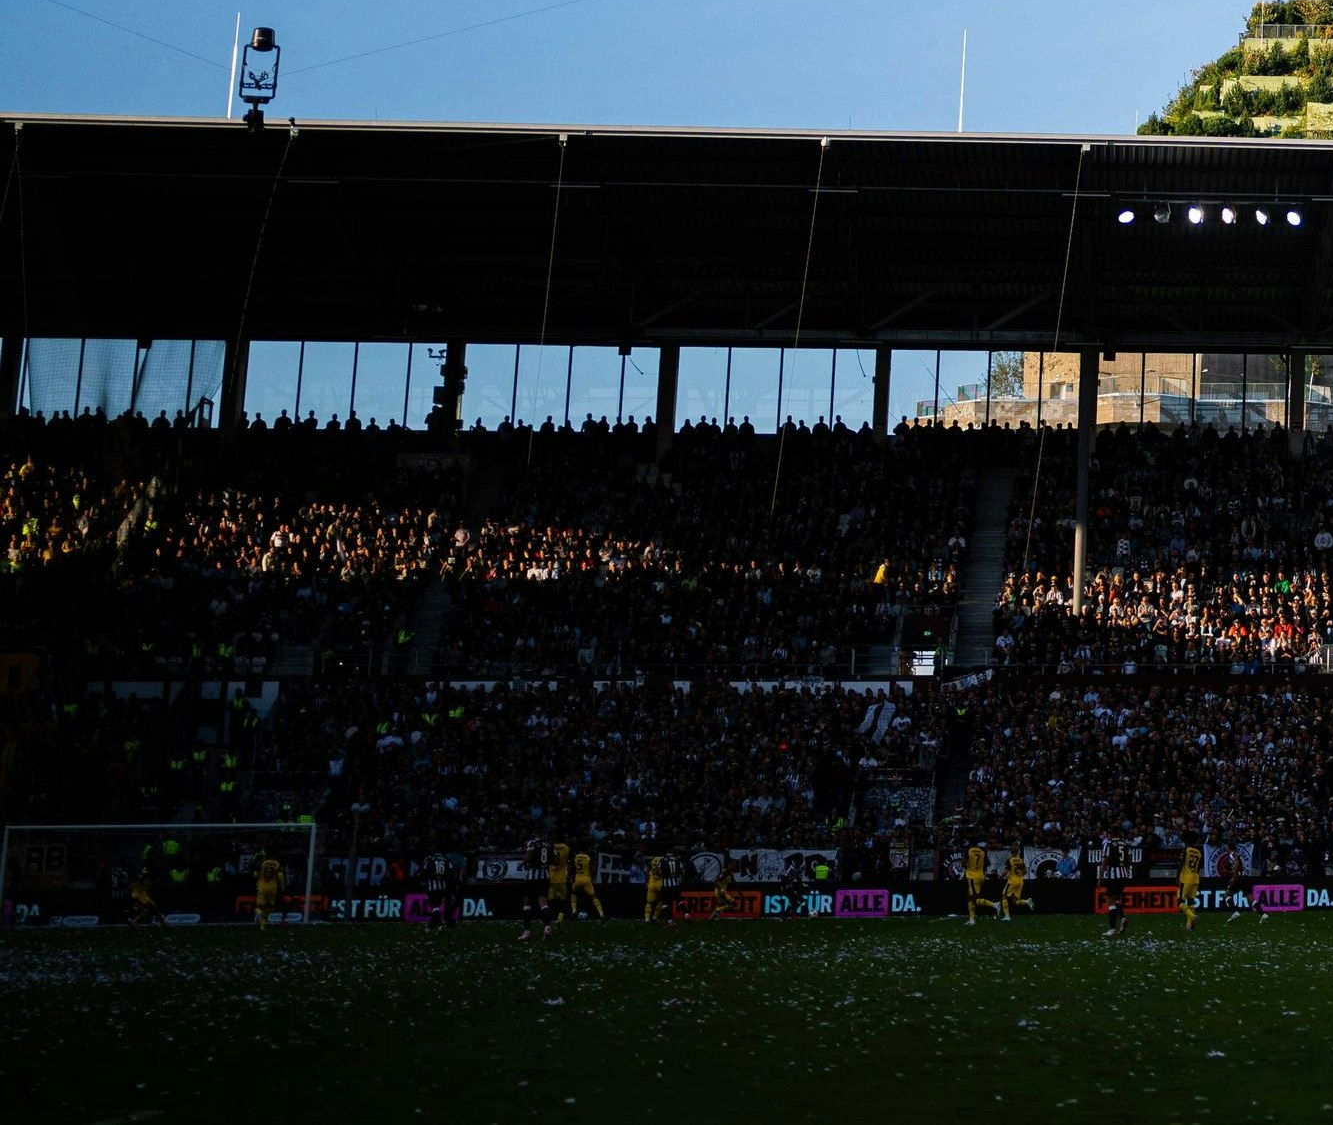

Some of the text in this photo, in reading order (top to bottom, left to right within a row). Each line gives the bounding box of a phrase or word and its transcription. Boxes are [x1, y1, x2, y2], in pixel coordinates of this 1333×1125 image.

[540, 847, 548, 863] 8
[1118, 845, 1125, 862] 5
[434, 860, 446, 875] 16
[363, 893, 402, 918] FÜR
[463, 897, 494, 917] DA.
[841, 893, 883, 913] ALLE
[892, 893, 922, 912] DA.
[1099, 889, 1174, 908] FEIHEIT
[1259, 889, 1300, 908] ALLE
